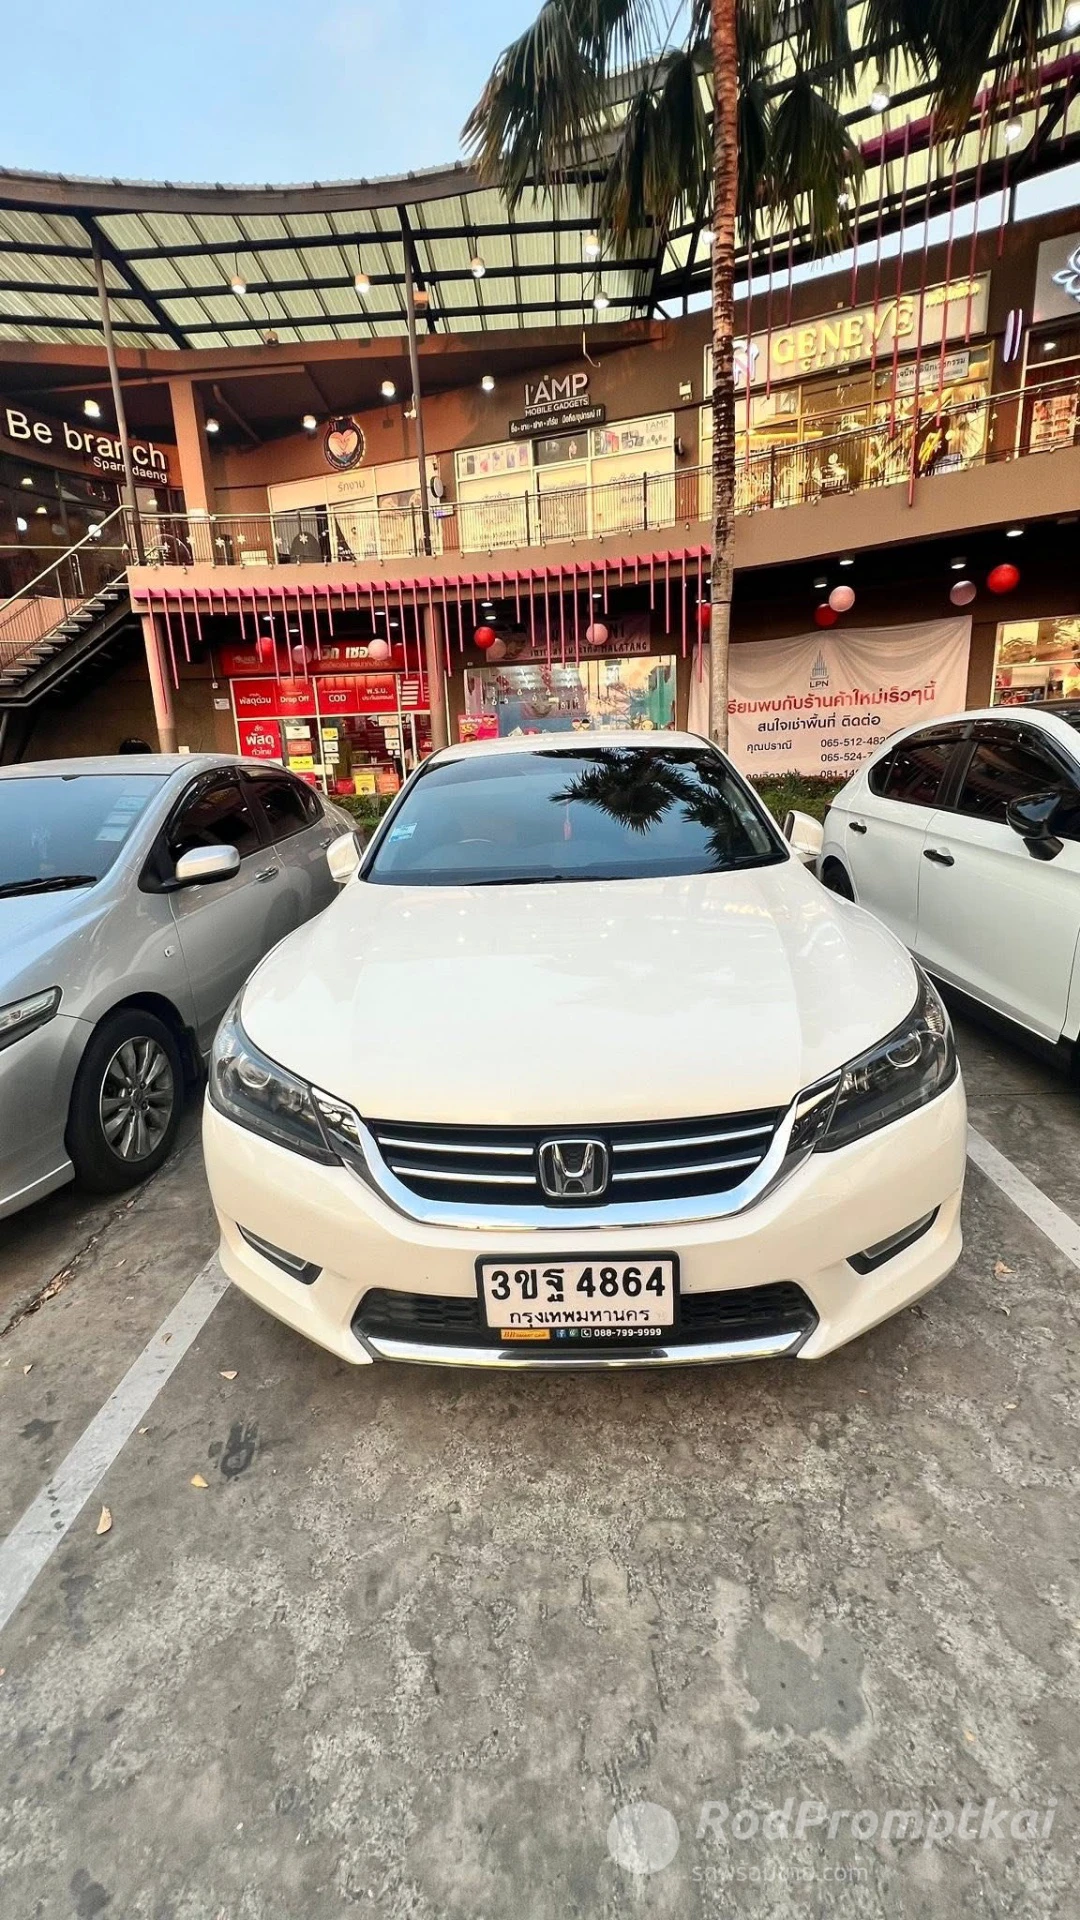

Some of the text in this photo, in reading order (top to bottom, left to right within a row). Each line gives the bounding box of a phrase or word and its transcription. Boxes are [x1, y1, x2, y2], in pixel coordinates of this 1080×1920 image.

[525, 398, 589, 417] MOBILE GADGETS
[5, 408, 167, 470] Be branch
[132, 465, 168, 483] daeng
[809, 680, 829, 688] LPN
[280, 696, 298, 704] Drop
[328, 694, 347, 703] COD
[757, 712, 881, 732] สนใจเช่าพื้นที่ ติดต่อ
[245, 732, 275, 748] พัสดุ
[746, 736, 888, 754] คุณปราณี 065-512-482
[491, 1266, 666, 1303] 3ขฐ 4864
[509, 1308, 650, 1328] กรุงเทพมหานคร
[594, 1328, 662, 1337] 088-799-9999
